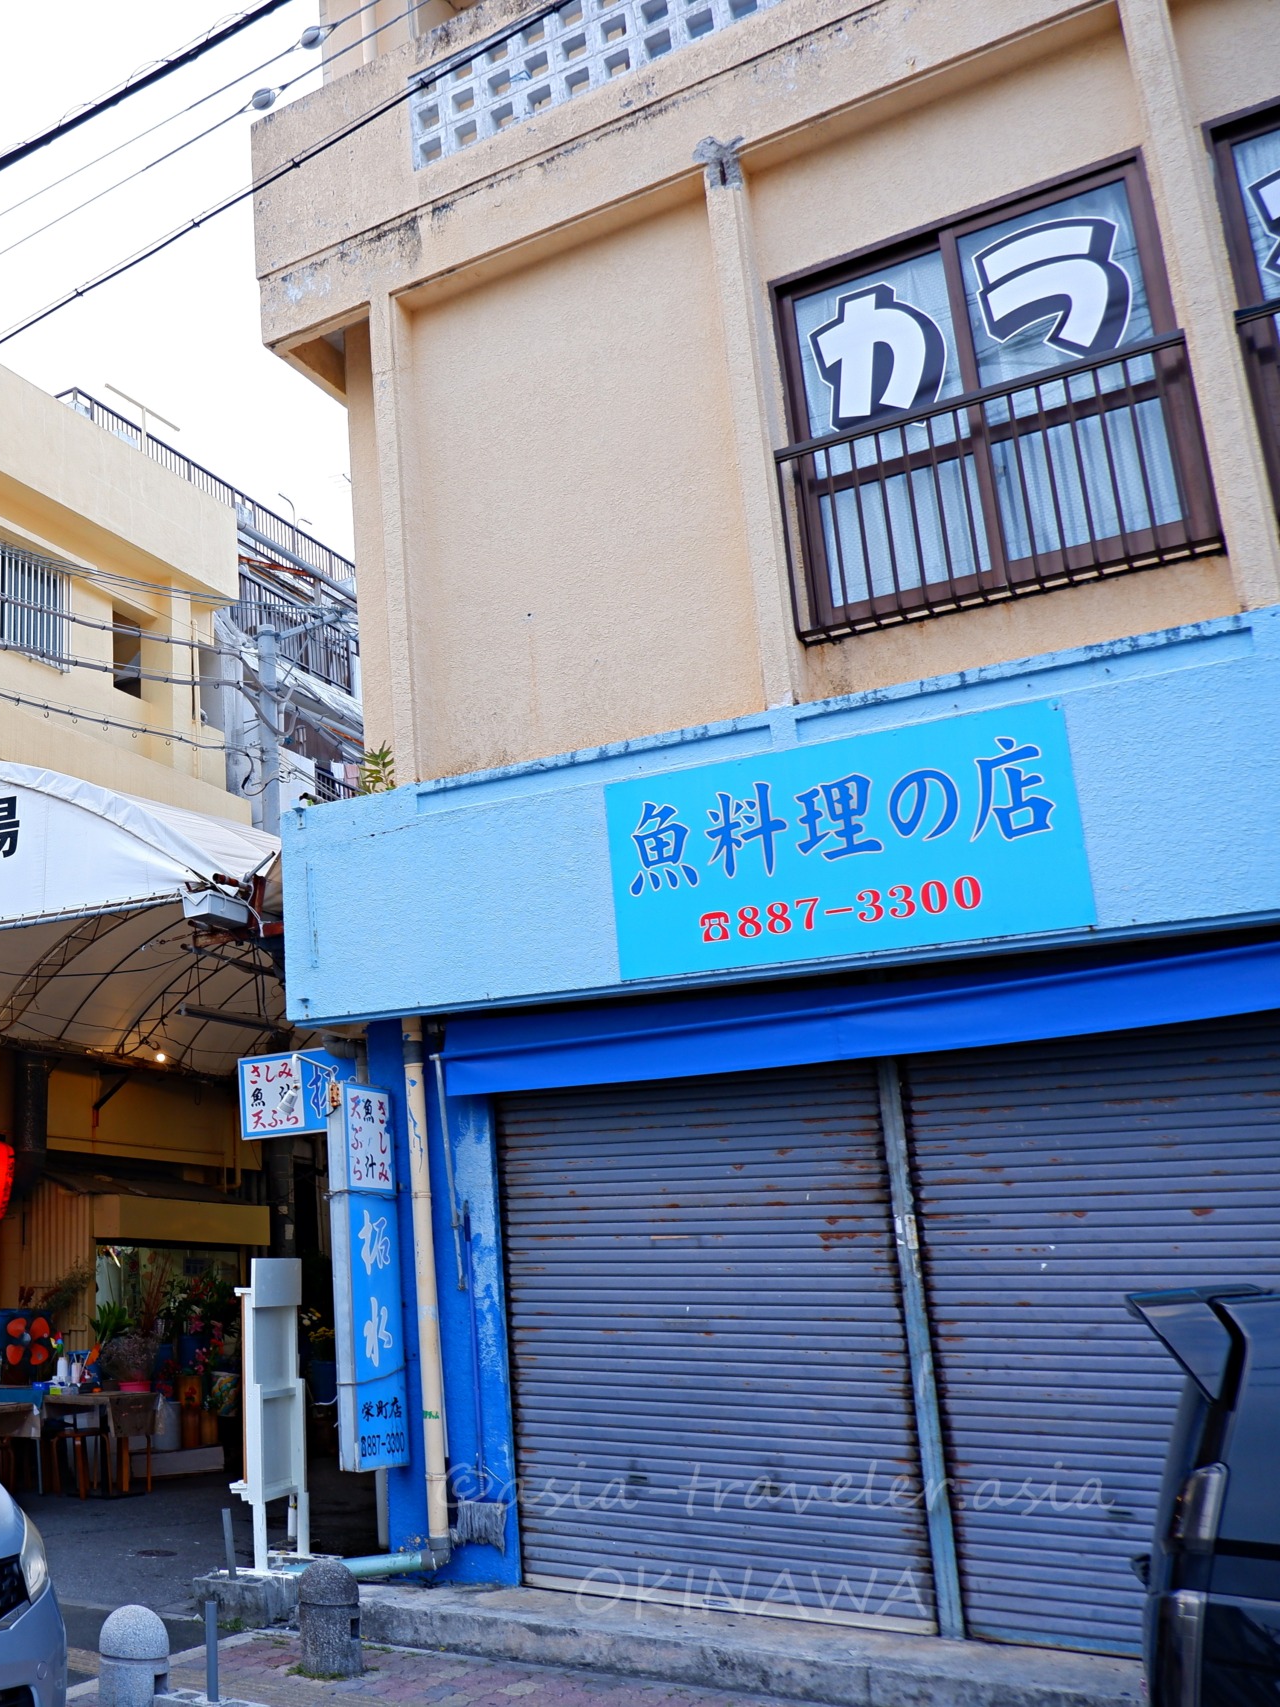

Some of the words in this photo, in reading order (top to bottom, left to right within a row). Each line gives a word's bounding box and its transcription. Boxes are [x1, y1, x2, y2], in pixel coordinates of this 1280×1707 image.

[628, 735, 1056, 898] 魚料理の店
[737, 875, 983, 939] 887-3300
[250, 1062, 293, 1084] さしみ
[350, 1095, 364, 1182] 天ぷら
[377, 1100, 390, 1183] さしみ
[357, 1208, 393, 1368] 拓水
[361, 1396, 403, 1422] 栄町店
[367, 1431, 405, 1457] 887-3300
